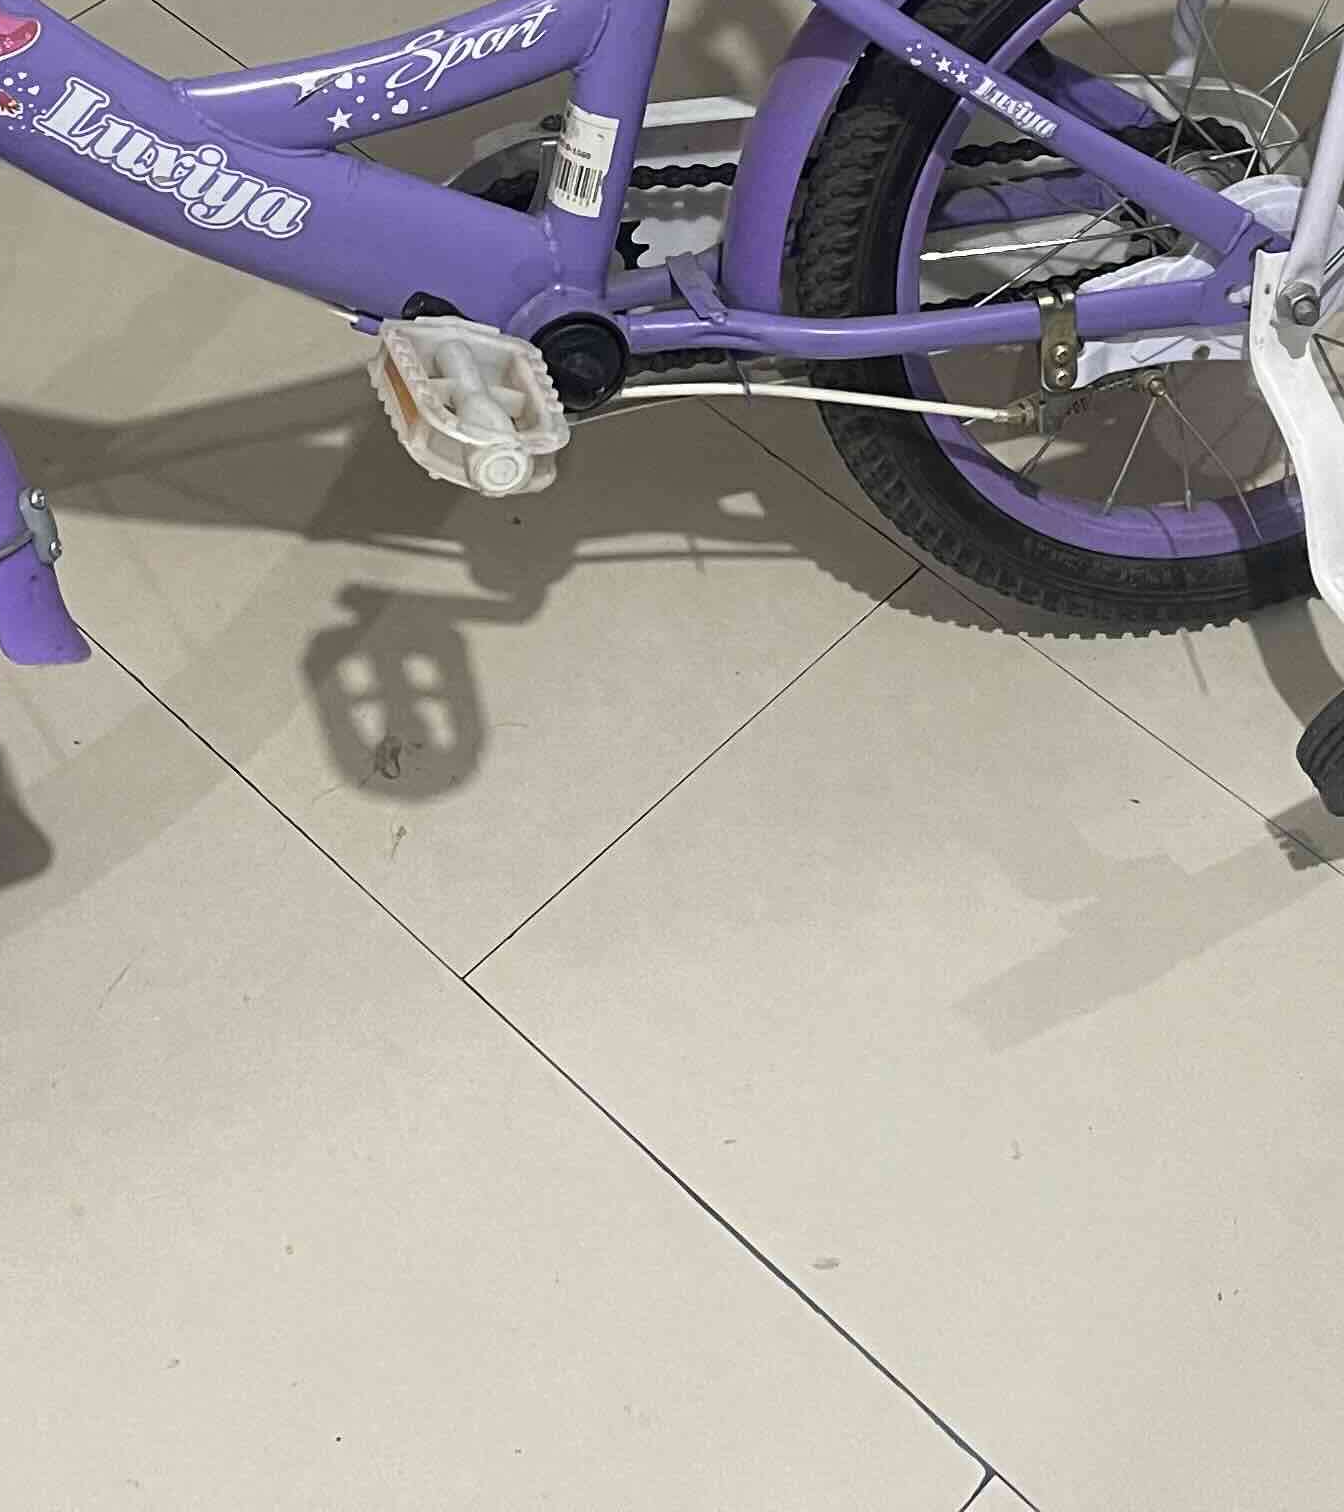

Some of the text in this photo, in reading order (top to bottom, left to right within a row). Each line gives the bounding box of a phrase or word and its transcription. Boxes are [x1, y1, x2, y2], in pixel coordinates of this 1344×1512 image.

[385, 0, 558, 92] Sport
[970, 75, 1060, 139] Luxiya
[32, 75, 312, 239] Luxiya
